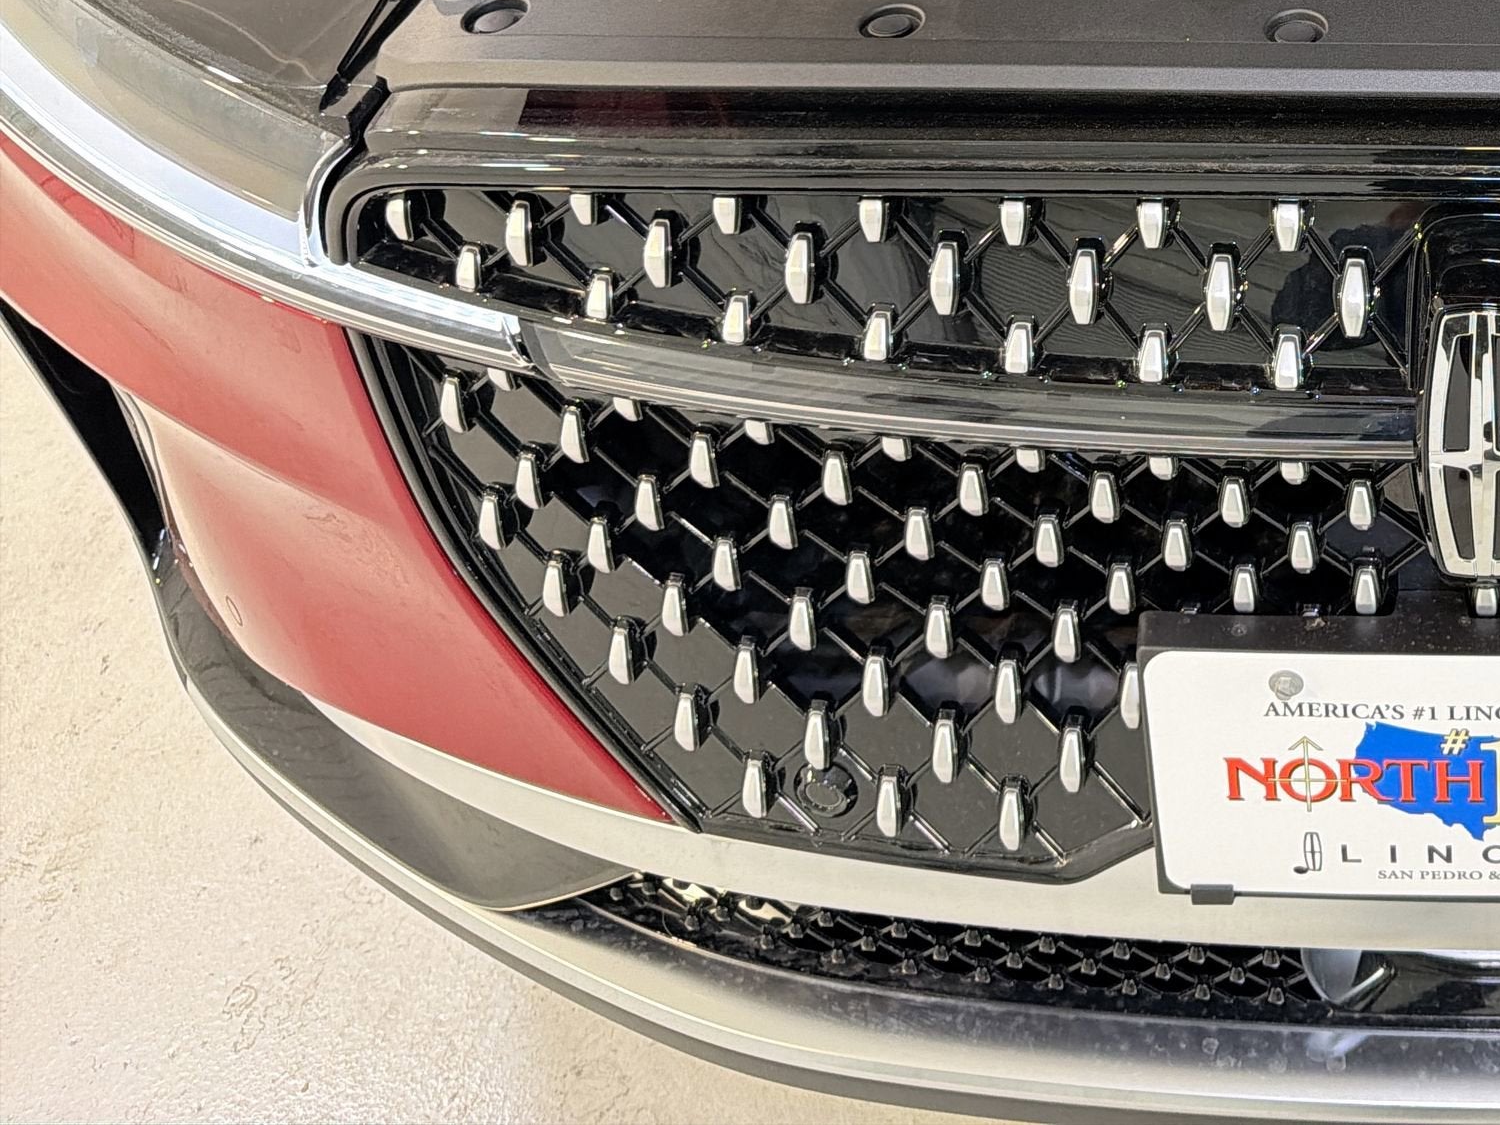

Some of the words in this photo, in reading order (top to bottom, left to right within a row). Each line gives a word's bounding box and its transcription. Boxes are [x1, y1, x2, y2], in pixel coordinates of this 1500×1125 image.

[1263, 701, 1405, 721] AMERICA'S
[1412, 705, 1438, 721] #1
[1223, 757, 1485, 803] NORTH
[1377, 869, 1414, 881] SAN
[1419, 869, 1486, 881] PEDRO
